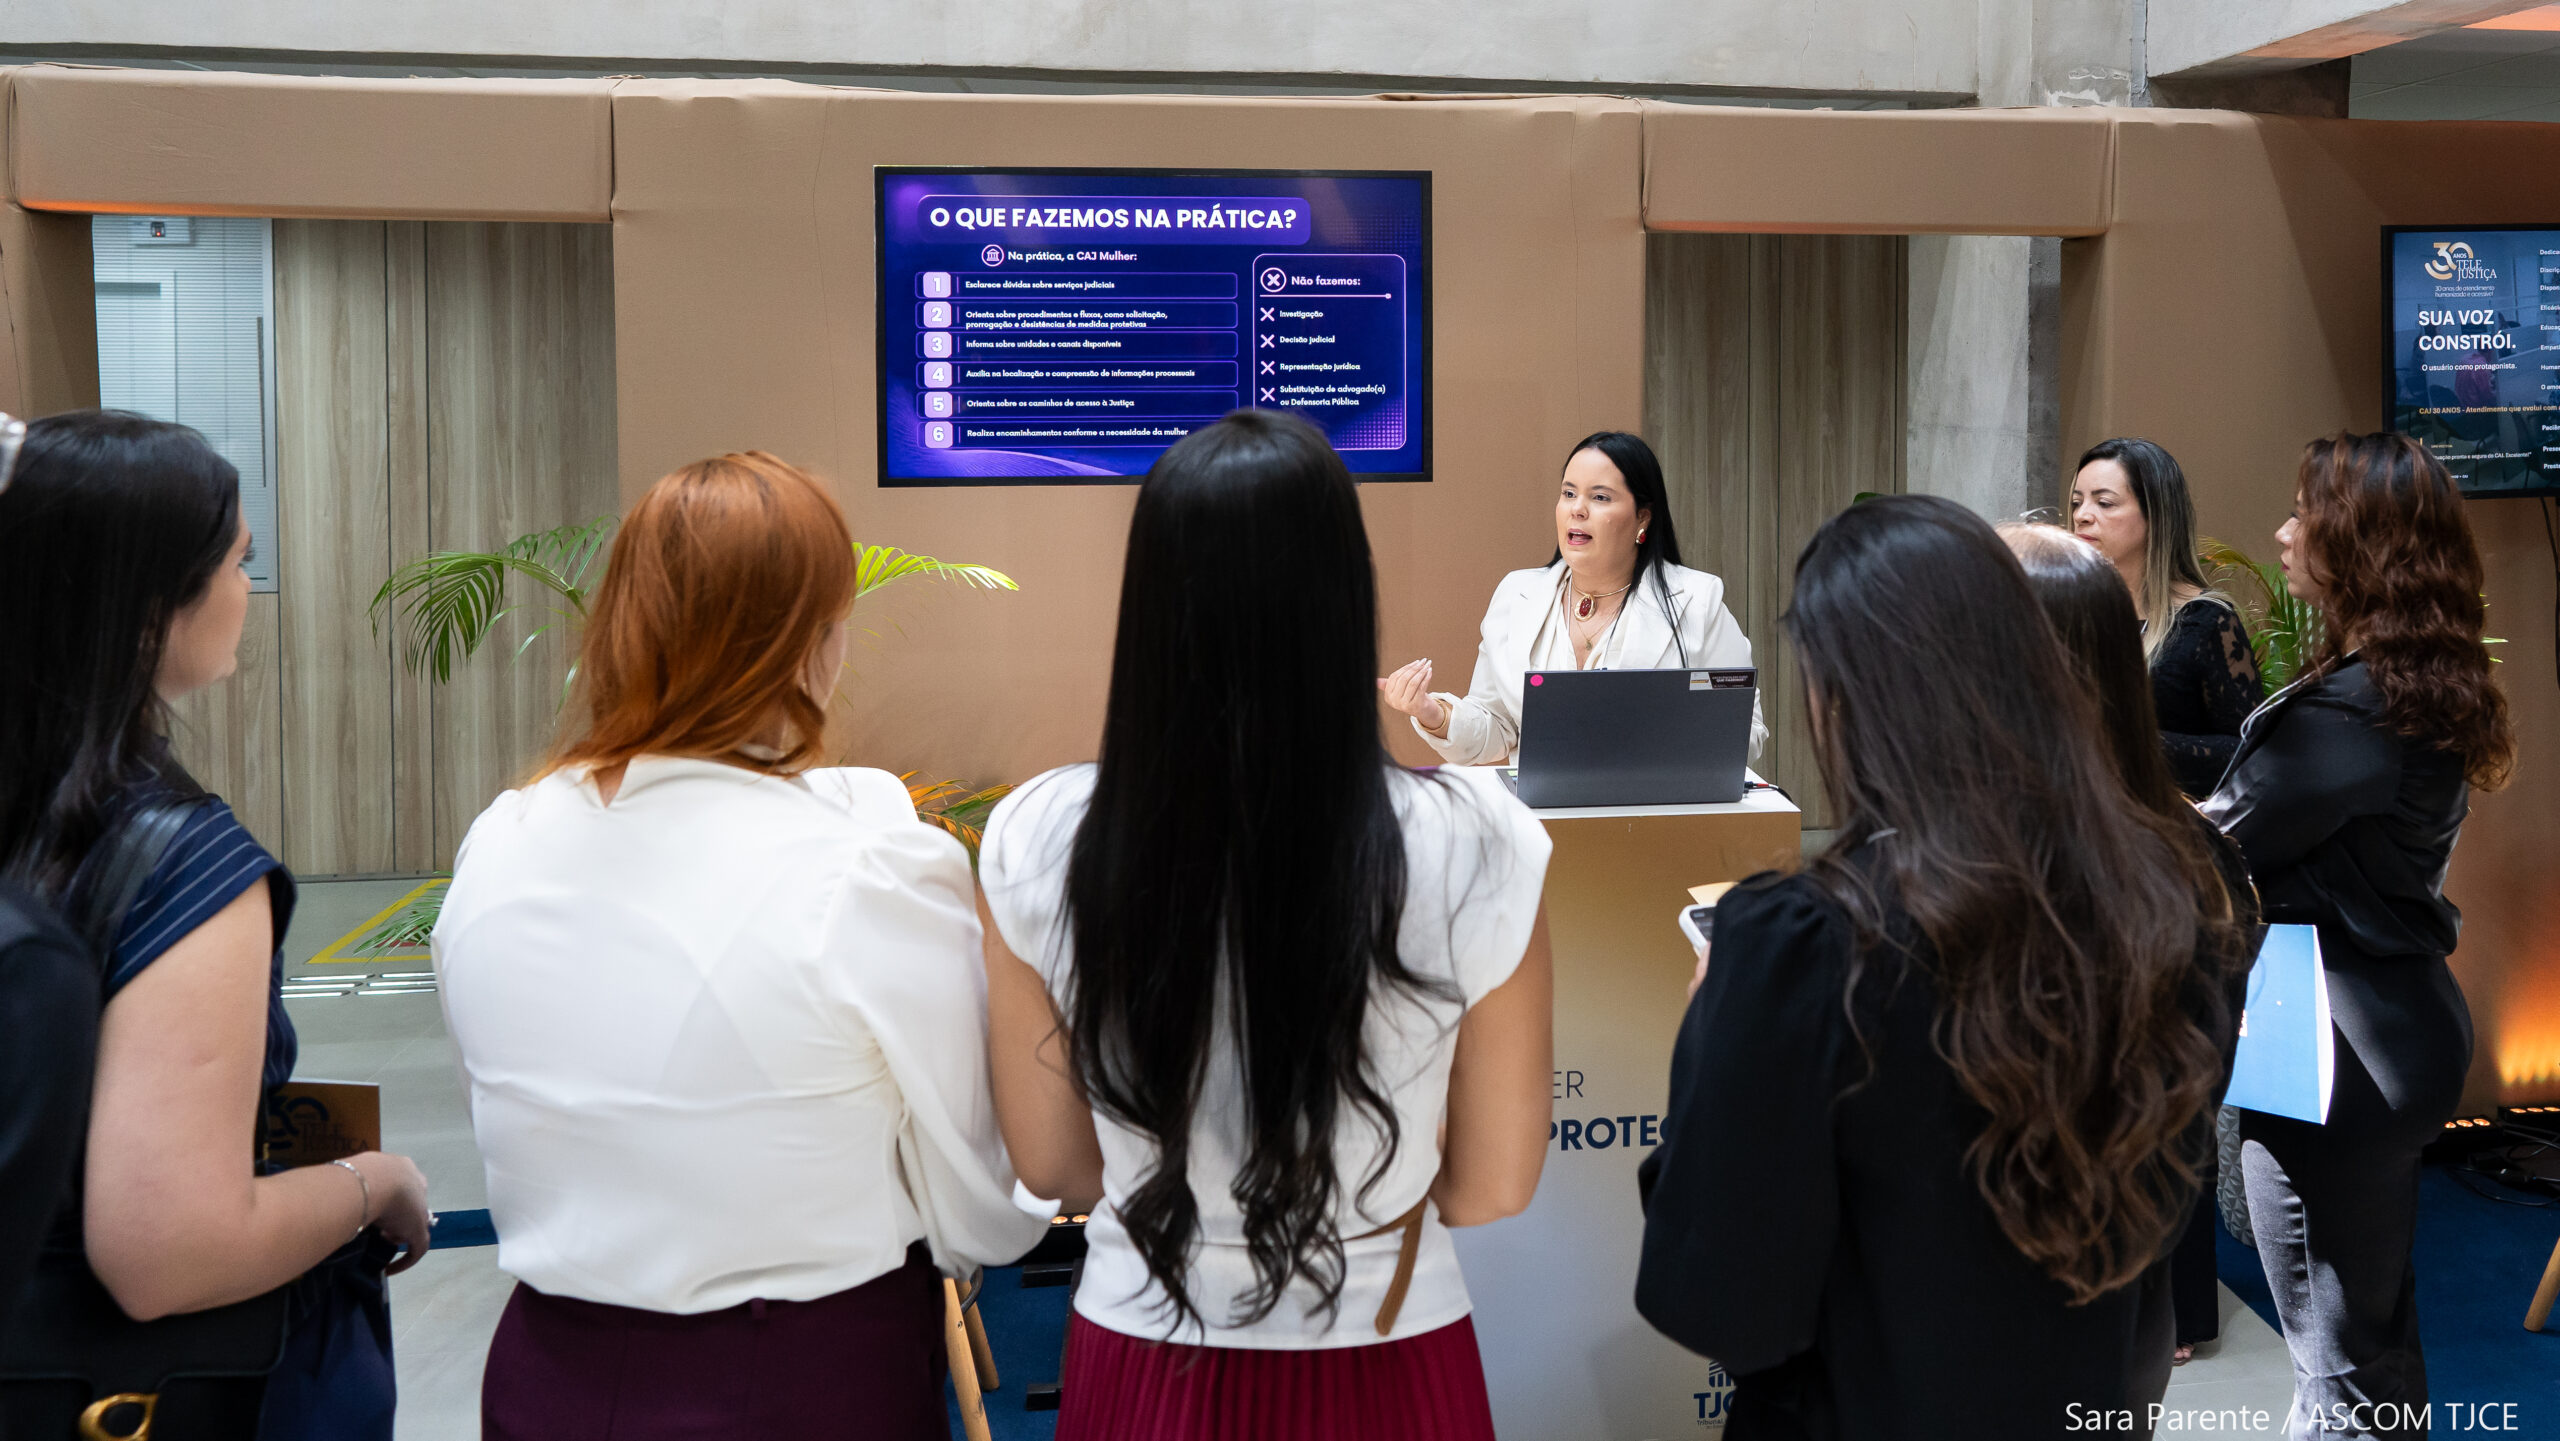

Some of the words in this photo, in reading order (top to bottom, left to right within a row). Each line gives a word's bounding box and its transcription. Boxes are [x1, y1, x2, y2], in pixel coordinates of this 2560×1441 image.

[930, 207, 950, 227] O
[955, 207, 1006, 230] QUE
[1012, 208, 1129, 228] FAZEMOS
[1135, 208, 1171, 228] NA
[1177, 203, 1297, 229] PRÁTICA?
[1008, 252, 1024, 261] Na
[1026, 251, 1064, 264] prática,
[1076, 252, 1097, 261] CAJ
[1100, 251, 1138, 261] Mulher:
[2456, 260, 2482, 270] TELE
[2457, 268, 2498, 282] JUSTIÇA
[933, 277, 941, 292] 1
[965, 281, 1001, 289] Esclarece
[1002, 280, 1031, 289] dúvidas
[1032, 280, 1052, 289] sobre
[1054, 281, 1083, 290] serviços
[1084, 281, 1115, 290] judiciais
[1291, 276, 1314, 286] Não
[1316, 275, 1361, 286] fazemos:
[932, 307, 943, 322] 2
[966, 310, 994, 318] Orienta
[996, 310, 1016, 318] sobre
[1018, 310, 1072, 320] procedimentos
[1080, 310, 1102, 319] fluxos,
[1126, 310, 1168, 320] solicitação,
[1280, 310, 1324, 319] Investigação
[2418, 310, 2455, 326] SUA
[2458, 310, 2494, 326] VOZ
[966, 321, 1013, 330] prorrogação
[1020, 320, 1066, 328] desistências
[1066, 320, 1076, 328] de
[1078, 320, 1109, 328] medidas
[1110, 320, 1147, 330] protetivas
[932, 337, 943, 352] 3
[966, 340, 994, 348] Informa
[996, 340, 1016, 348] sobre
[1017, 340, 1050, 348] unidades
[1057, 340, 1081, 348] canais
[1082, 340, 1122, 350] disponíveis
[1308, 336, 1336, 345] judicial
[2418, 330, 2516, 351] CONSTRÓI.
[1280, 363, 1332, 372] Representação
[1333, 362, 1360, 372] jurídica
[2422, 364, 2428, 372] O
[2474, 362, 2518, 371] protagonista.
[932, 367, 944, 382] 4
[1002, 369, 1044, 378] localização
[1052, 370, 1099, 378] compreensão
[1112, 369, 1154, 378] informações
[1156, 370, 1196, 378] processuais
[1280, 385, 1324, 394] Substituição
[1338, 384, 1386, 394] advogado(a)
[933, 397, 944, 412] 5
[966, 399, 996, 407] Orienta
[996, 398, 1018, 407] sobre
[1028, 398, 1063, 407] caminhos
[1064, 398, 1074, 406] de
[1108, 399, 1135, 408] Justiça
[1291, 398, 1330, 406] Defensoria
[1332, 397, 1360, 406] Pública
[933, 427, 944, 442] 6
[967, 428, 994, 436] Realiza
[996, 428, 1062, 436] encaminhamentos
[1063, 428, 1098, 436] conforme
[1106, 428, 1151, 436] necessidade
[1152, 428, 1162, 436] da
[1164, 427, 1188, 436] mulher
[1552, 1070, 1584, 1099] ER
